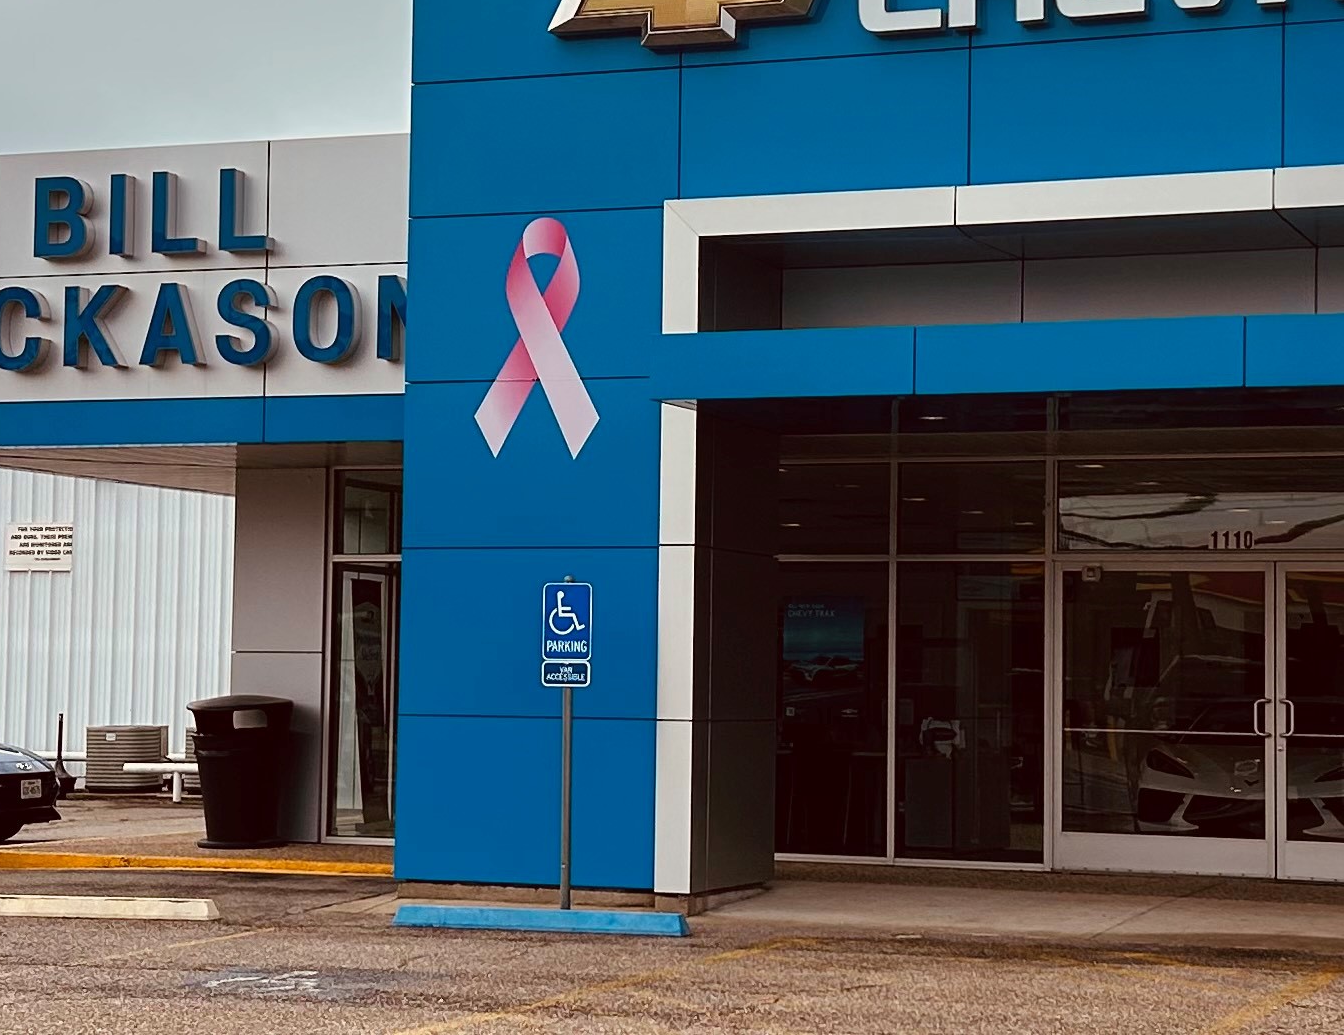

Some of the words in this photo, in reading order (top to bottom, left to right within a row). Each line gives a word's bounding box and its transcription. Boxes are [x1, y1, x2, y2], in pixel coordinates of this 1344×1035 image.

[34, 168, 275, 258] BILL
[1210, 530, 1253, 549] 1110
[546, 640, 588, 653] PARKING
[559, 666, 573, 674] VAN
[545, 673, 586, 682] ACCESSIBLE
